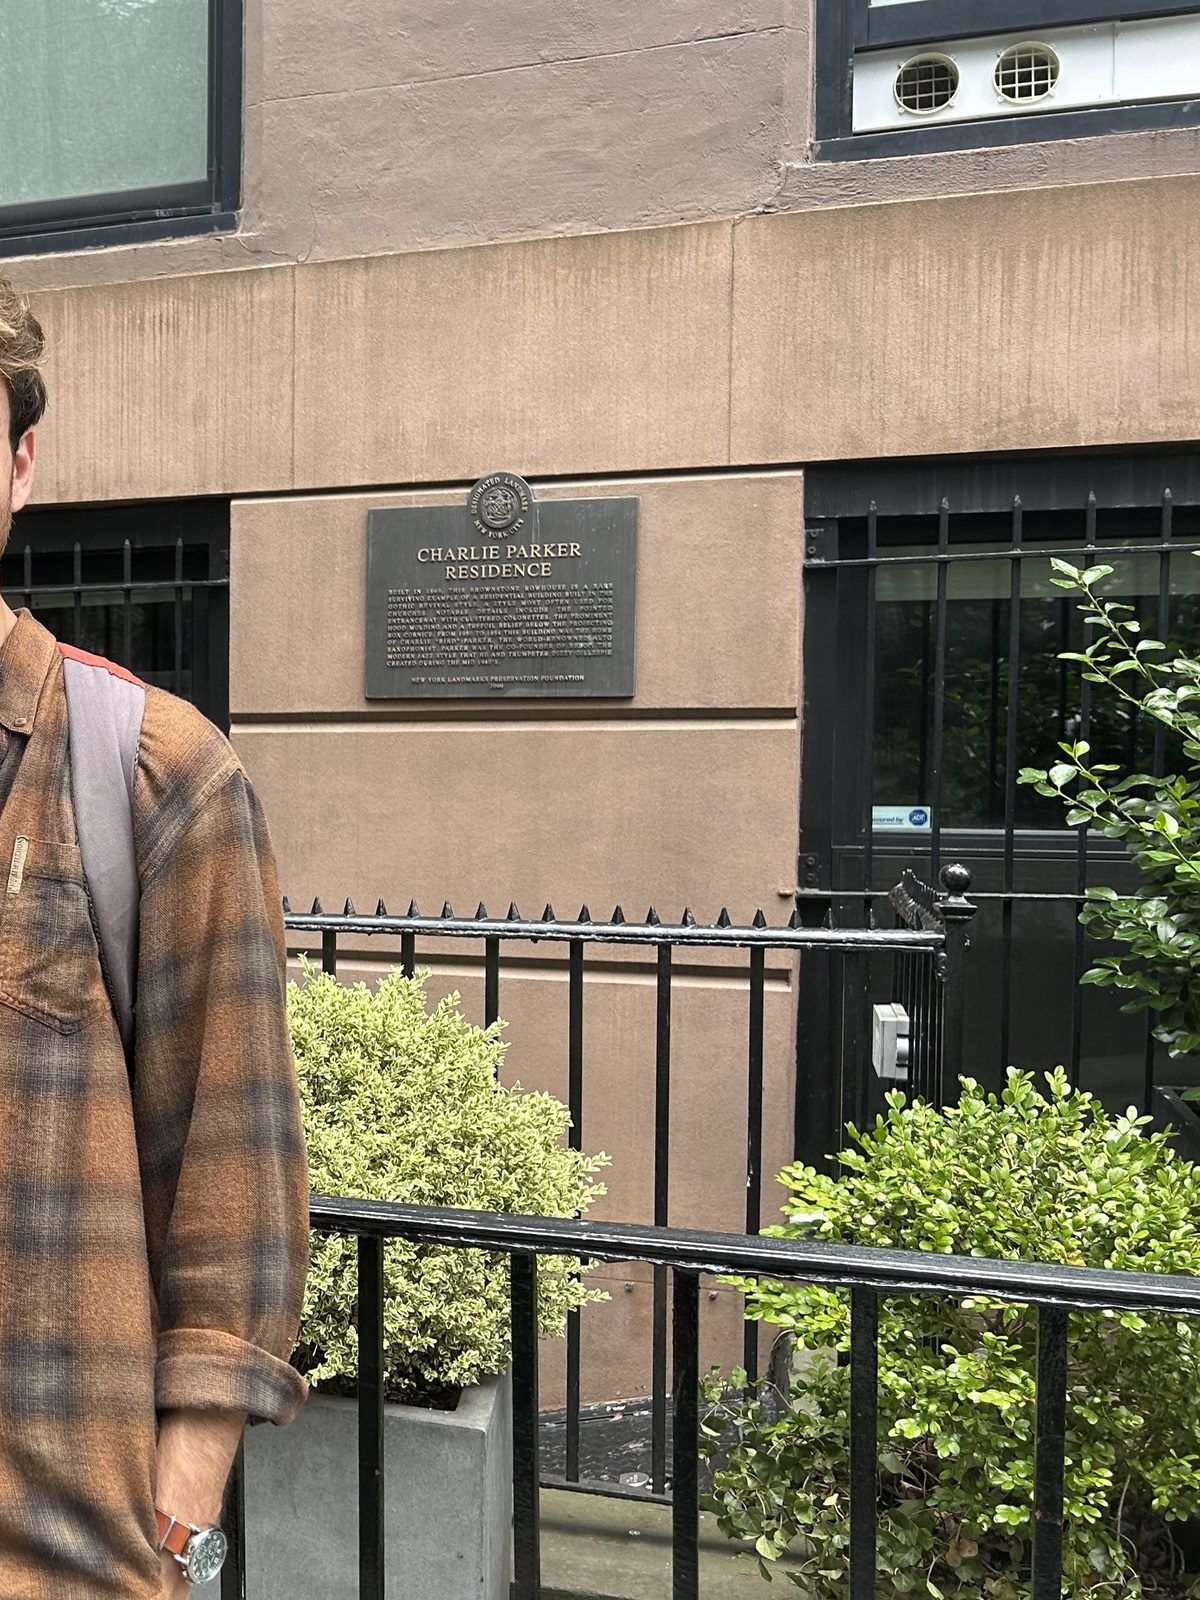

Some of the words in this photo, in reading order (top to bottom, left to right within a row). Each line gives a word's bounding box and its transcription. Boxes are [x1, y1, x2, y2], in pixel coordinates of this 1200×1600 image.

[417, 545, 501, 562] CHARLIE
[505, 542, 583, 559] PARKER
[444, 563, 553, 580] RESIDENCE
[388, 588, 410, 596] BUILT
[469, 586, 521, 594] BROWNSTONE
[388, 595, 425, 603] SURVIVING
[427, 594, 458, 602] EXAMPLE
